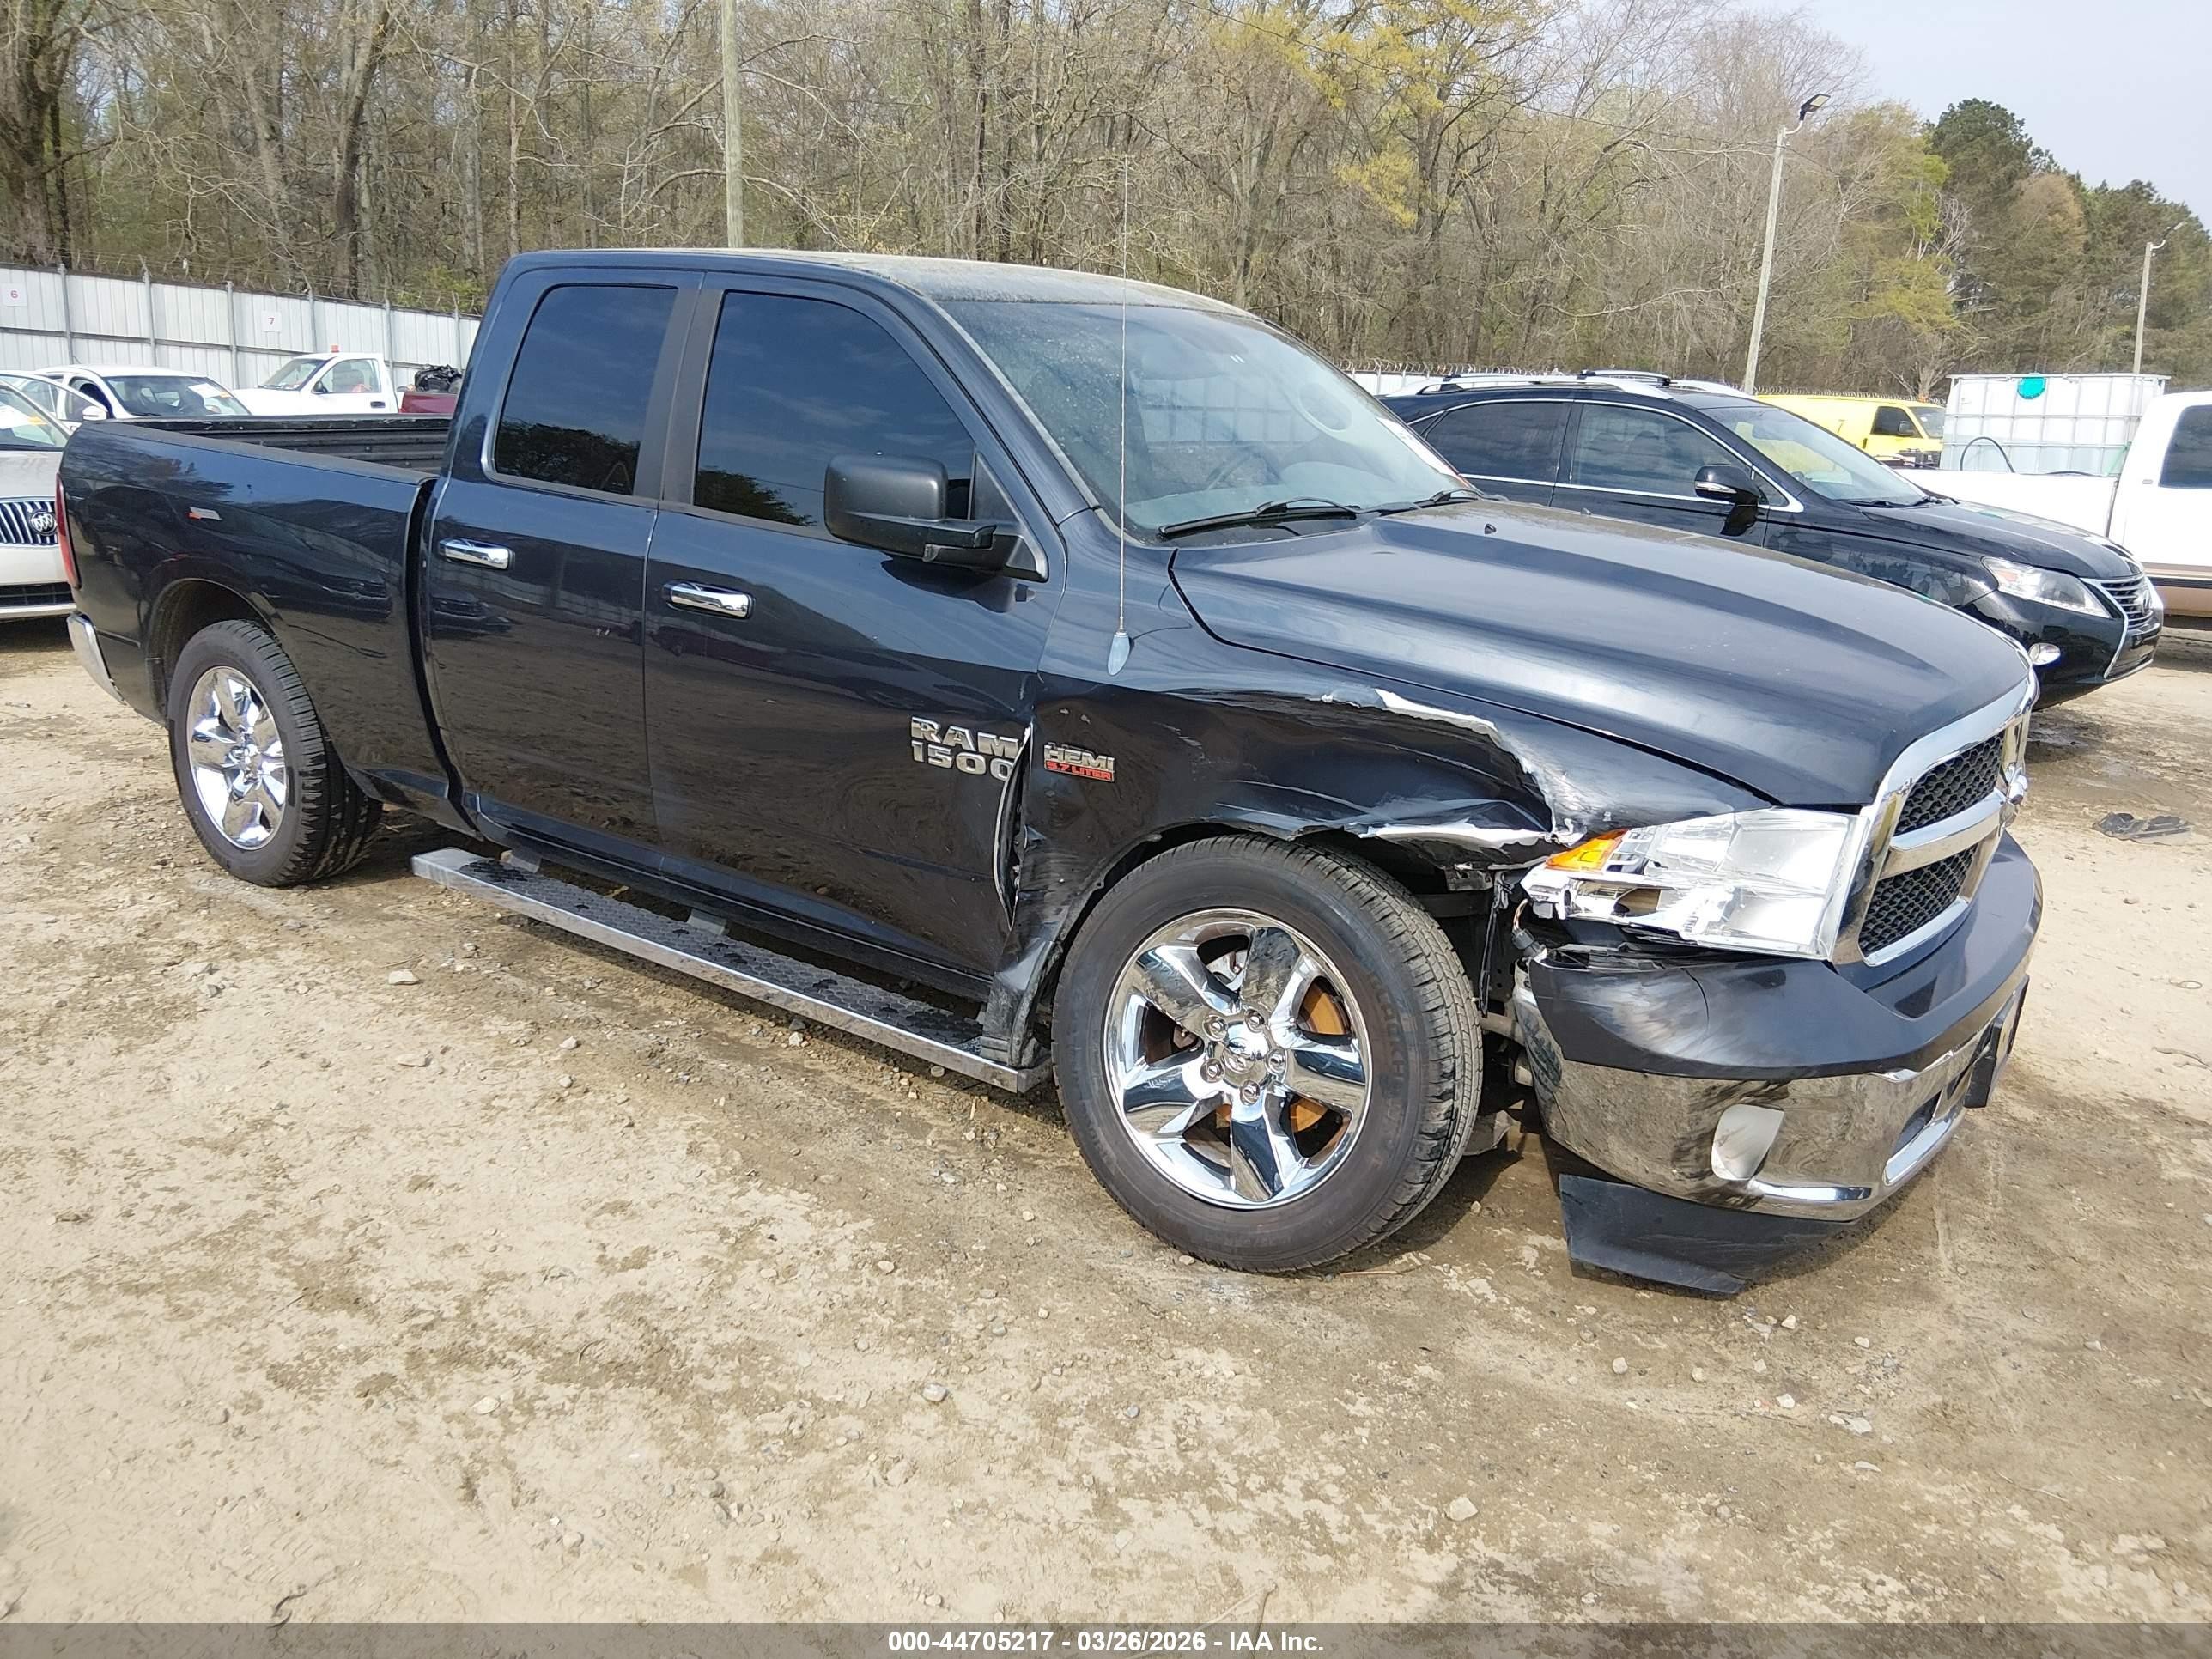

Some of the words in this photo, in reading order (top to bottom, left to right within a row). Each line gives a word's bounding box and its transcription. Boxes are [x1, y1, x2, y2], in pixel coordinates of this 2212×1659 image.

[9, 289, 19, 299] 6
[267, 317, 276, 325] 7
[910, 716, 1019, 759] RAM
[911, 739, 1014, 783] 1500
[1043, 744, 1115, 771] HEMI
[1046, 761, 1070, 771] 5.7
[1071, 765, 1112, 780] LITER
